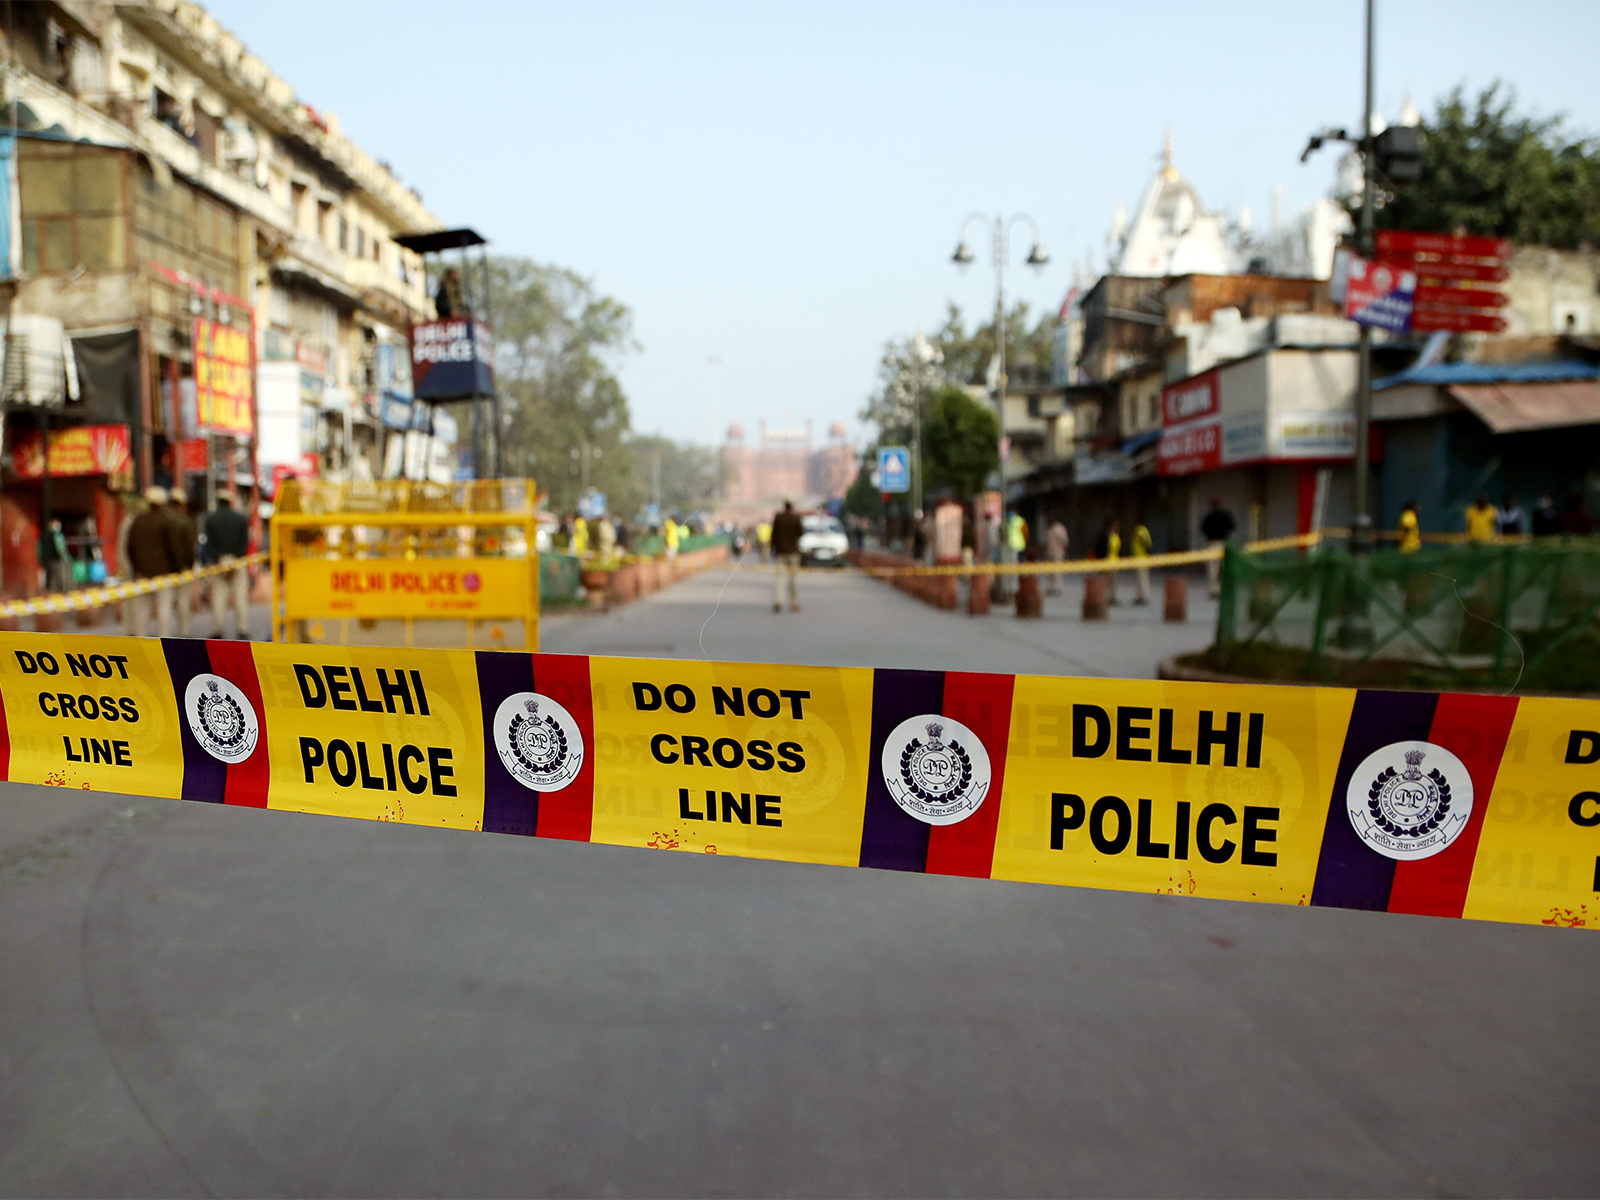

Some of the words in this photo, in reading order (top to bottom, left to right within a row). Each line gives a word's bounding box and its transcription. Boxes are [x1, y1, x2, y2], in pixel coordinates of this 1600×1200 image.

[413, 322, 468, 342] DELHI
[413, 339, 473, 363] POLICE
[330, 570, 386, 593] DELHI
[390, 570, 459, 593] POLICE
[15, 651, 59, 675] DO
[65, 654, 128, 679] NOT
[293, 664, 430, 715] DELHI
[632, 682, 695, 713] DO
[712, 687, 810, 719] NOT
[39, 692, 139, 722] CROSS
[1073, 704, 1263, 768] DELHI
[63, 737, 132, 766] LINE
[651, 734, 805, 772] CROSS
[299, 737, 457, 797] POLICE
[1384, 778, 1401, 798] POLICE
[679, 789, 782, 827] LINE
[1384, 801, 1397, 818] DELHI
[1051, 793, 1279, 866] POLICE
